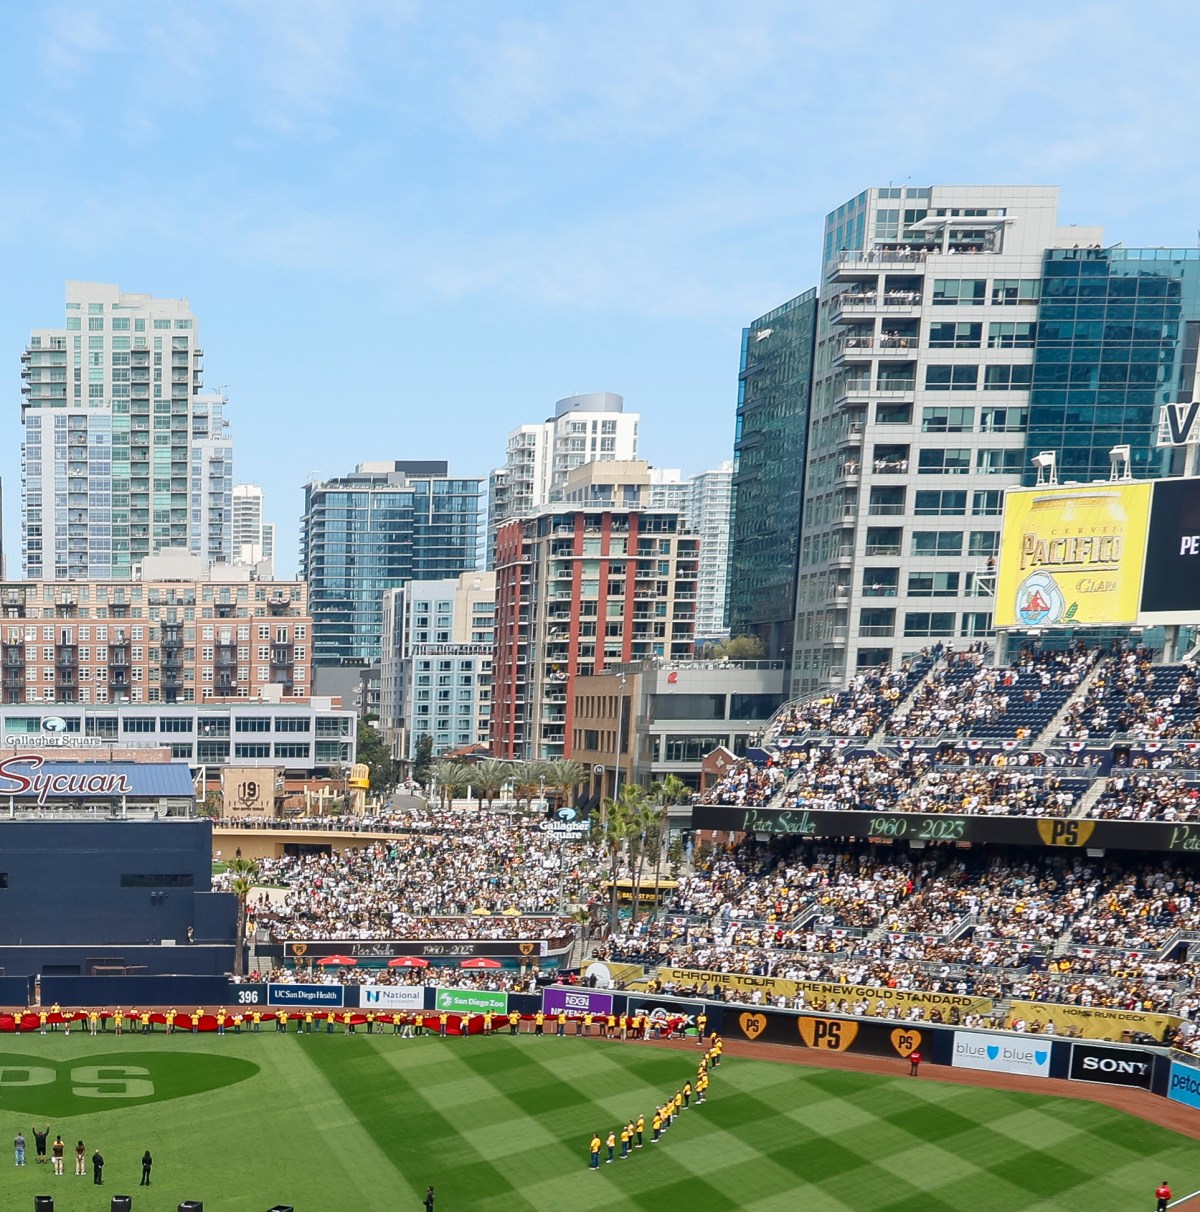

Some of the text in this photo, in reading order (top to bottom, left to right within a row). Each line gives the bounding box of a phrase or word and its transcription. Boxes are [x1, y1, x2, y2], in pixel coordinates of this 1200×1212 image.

[5, 735, 101, 746] Gallagher Square
[242, 781, 256, 796] 19
[742, 810, 816, 834] Peter Seidler
[868, 818, 965, 839] 1960 2023
[1052, 820, 1078, 845] PS
[422, 945, 474, 955] 1960 2023
[672, 970, 776, 987] CHROME TOUR
[238, 991, 258, 1003] 396
[274, 990, 337, 1001] UC San Diego Health
[383, 990, 420, 999] National
[794, 982, 822, 993] THE
[823, 985, 854, 995] NEW
[856, 988, 893, 1000] GOLD
[468, 999, 489, 1007] Diego
[489, 1000, 504, 1008] Zoo
[1094, 1011, 1117, 1020] RUN
[1118, 1013, 1147, 1022] DECK
[746, 1019, 759, 1031] PS
[813, 1020, 841, 1050] PS
[899, 1035, 913, 1049] PS
[956, 1042, 986, 1056] blue
[1003, 1047, 1034, 1061] blue
[1083, 1056, 1149, 1076] SONY
